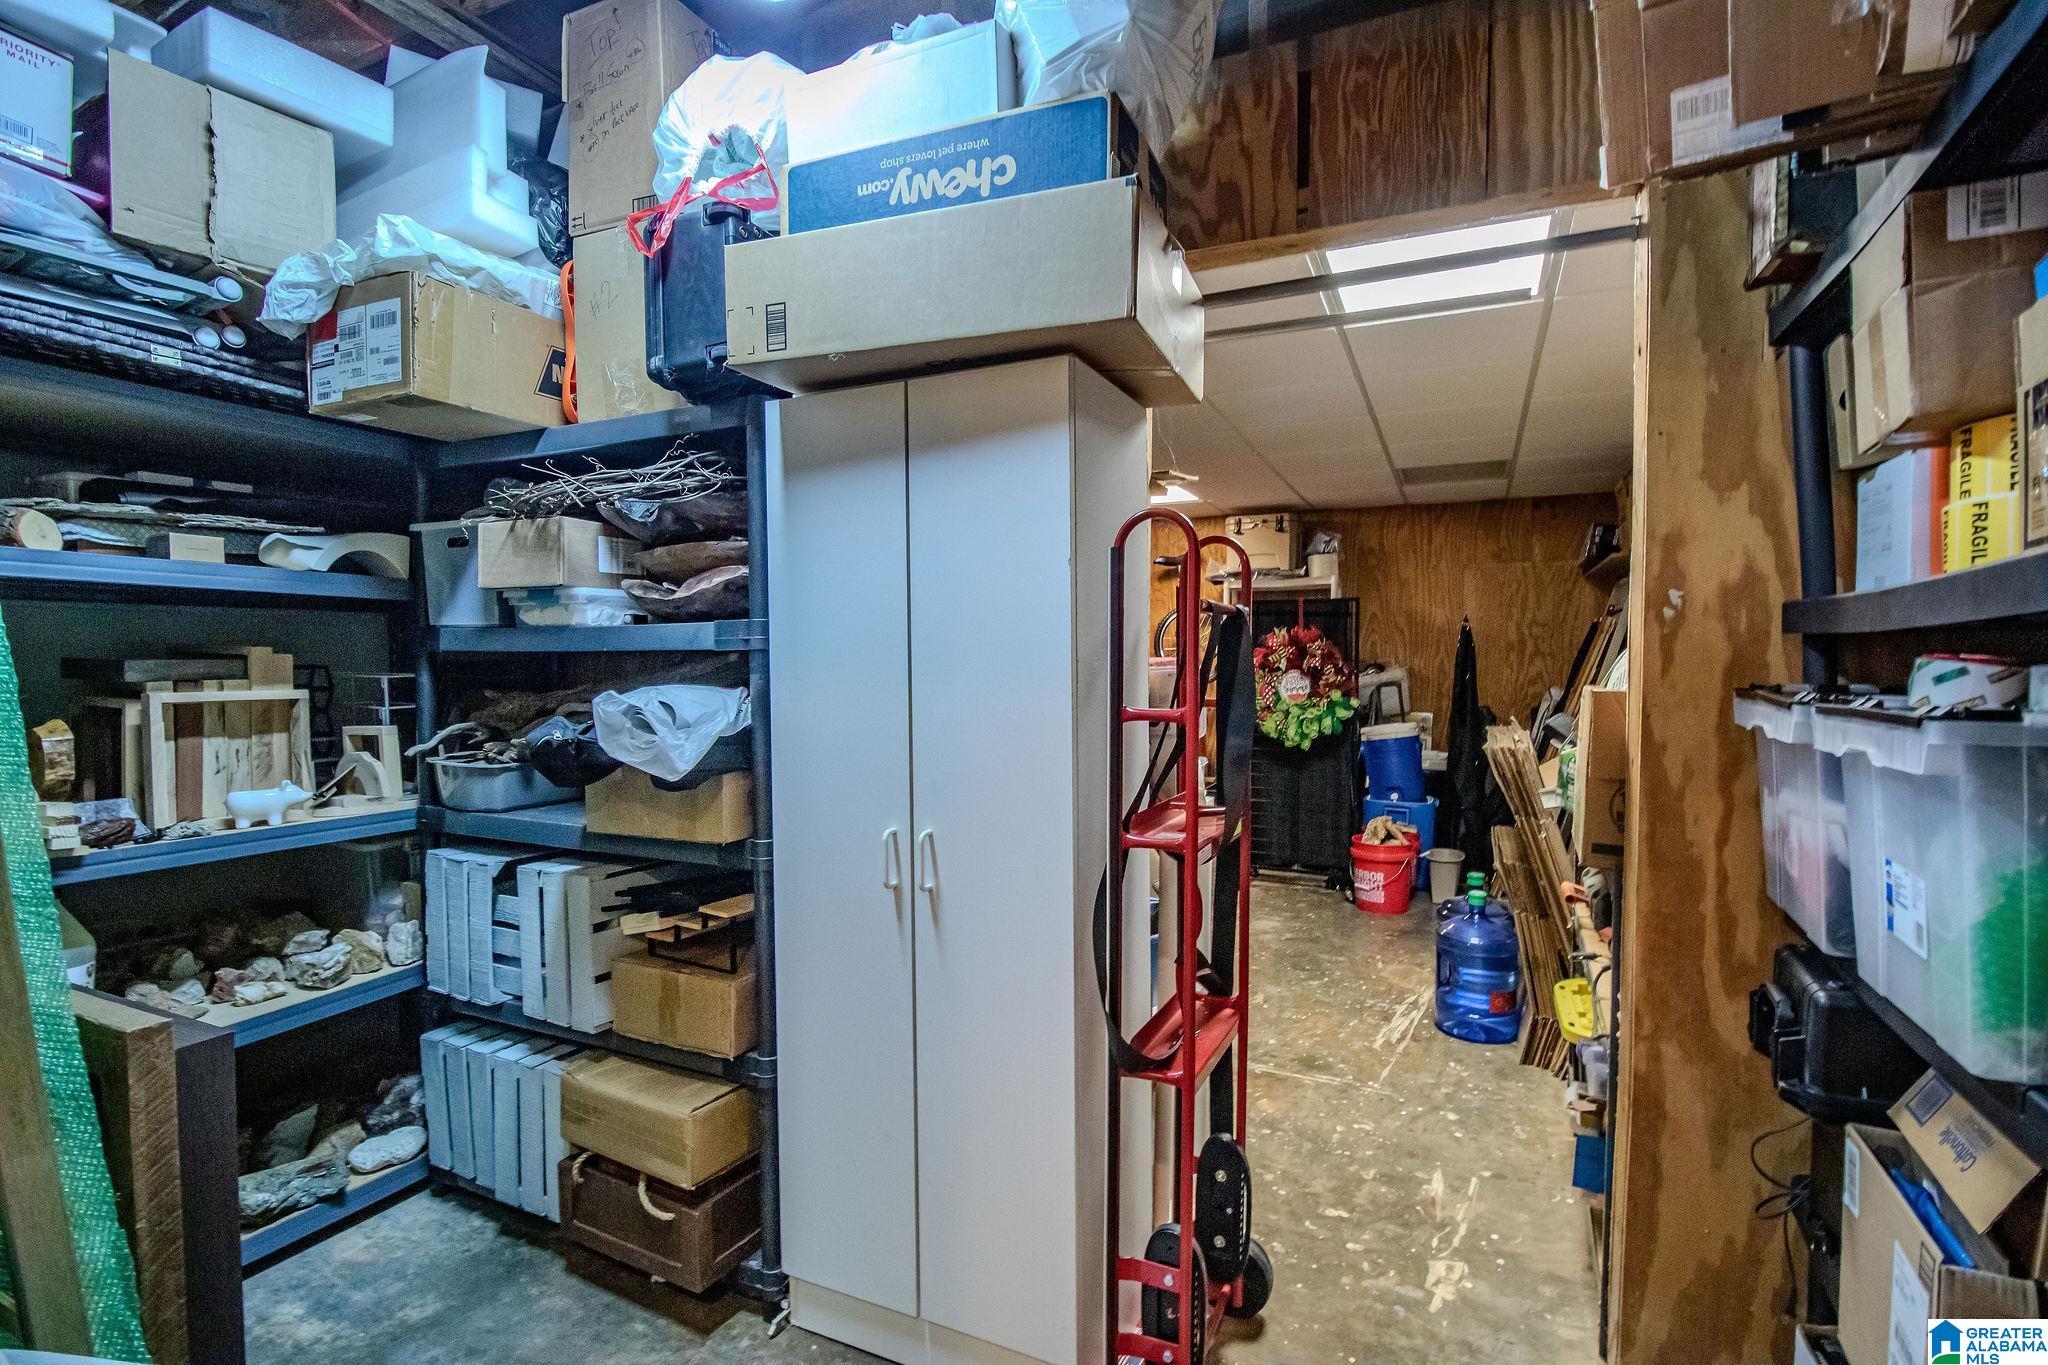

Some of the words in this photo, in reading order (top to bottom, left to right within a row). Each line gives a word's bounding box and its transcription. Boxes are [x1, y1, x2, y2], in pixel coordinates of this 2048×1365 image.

[0, 37, 57, 67] RIORITY
[6, 49, 41, 70] MAIL
[907, 149, 938, 163] lovers
[939, 144, 956, 158] pet
[957, 137, 990, 152] where
[880, 154, 905, 169] shop
[857, 154, 1017, 206] chewy.com
[1960, 426, 1973, 500] FRAGILE
[1971, 501, 1989, 565] FRAGIL
[1938, 1126, 1977, 1172] Cottonelle
